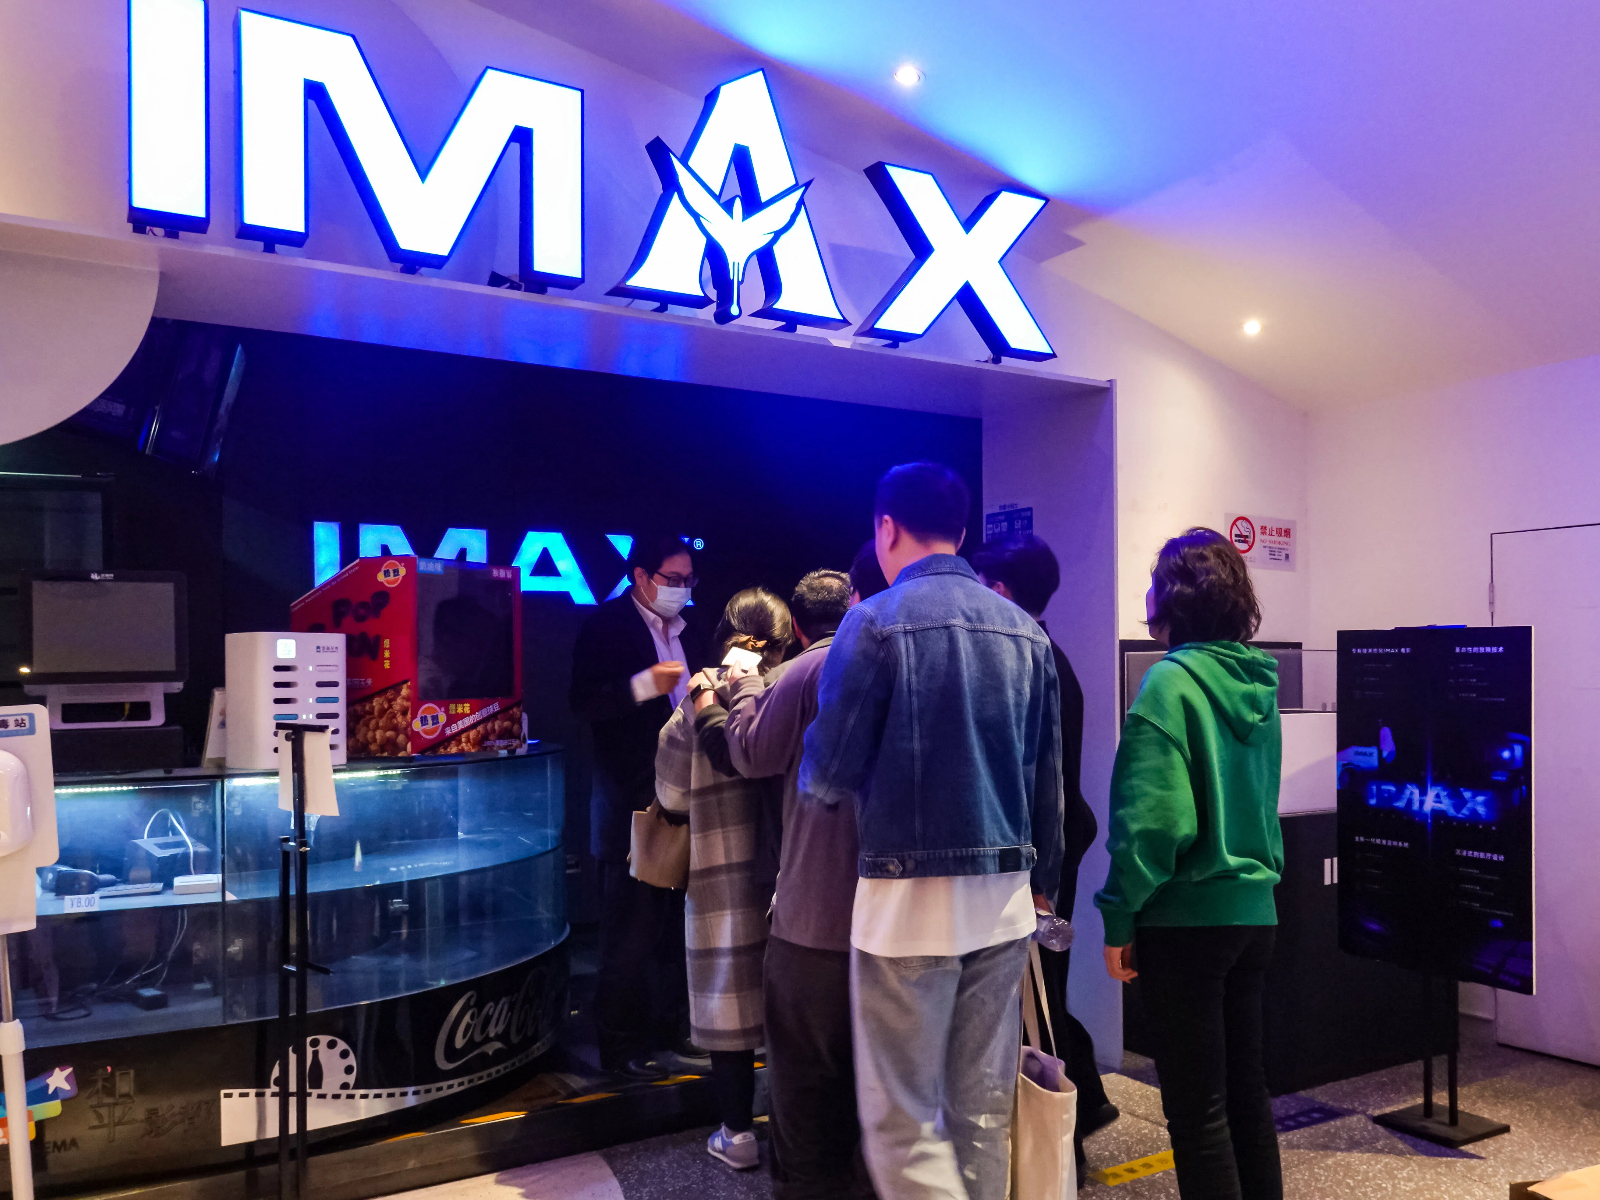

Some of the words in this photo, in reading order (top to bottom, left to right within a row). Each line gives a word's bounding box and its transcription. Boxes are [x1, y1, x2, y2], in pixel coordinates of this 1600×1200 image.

[128, 0, 1057, 360] IMAX
[1260, 525, 1291, 539] 禁止吸烟
[332, 591, 390, 628] POP
[70, 896, 96, 909] ¥8.00
